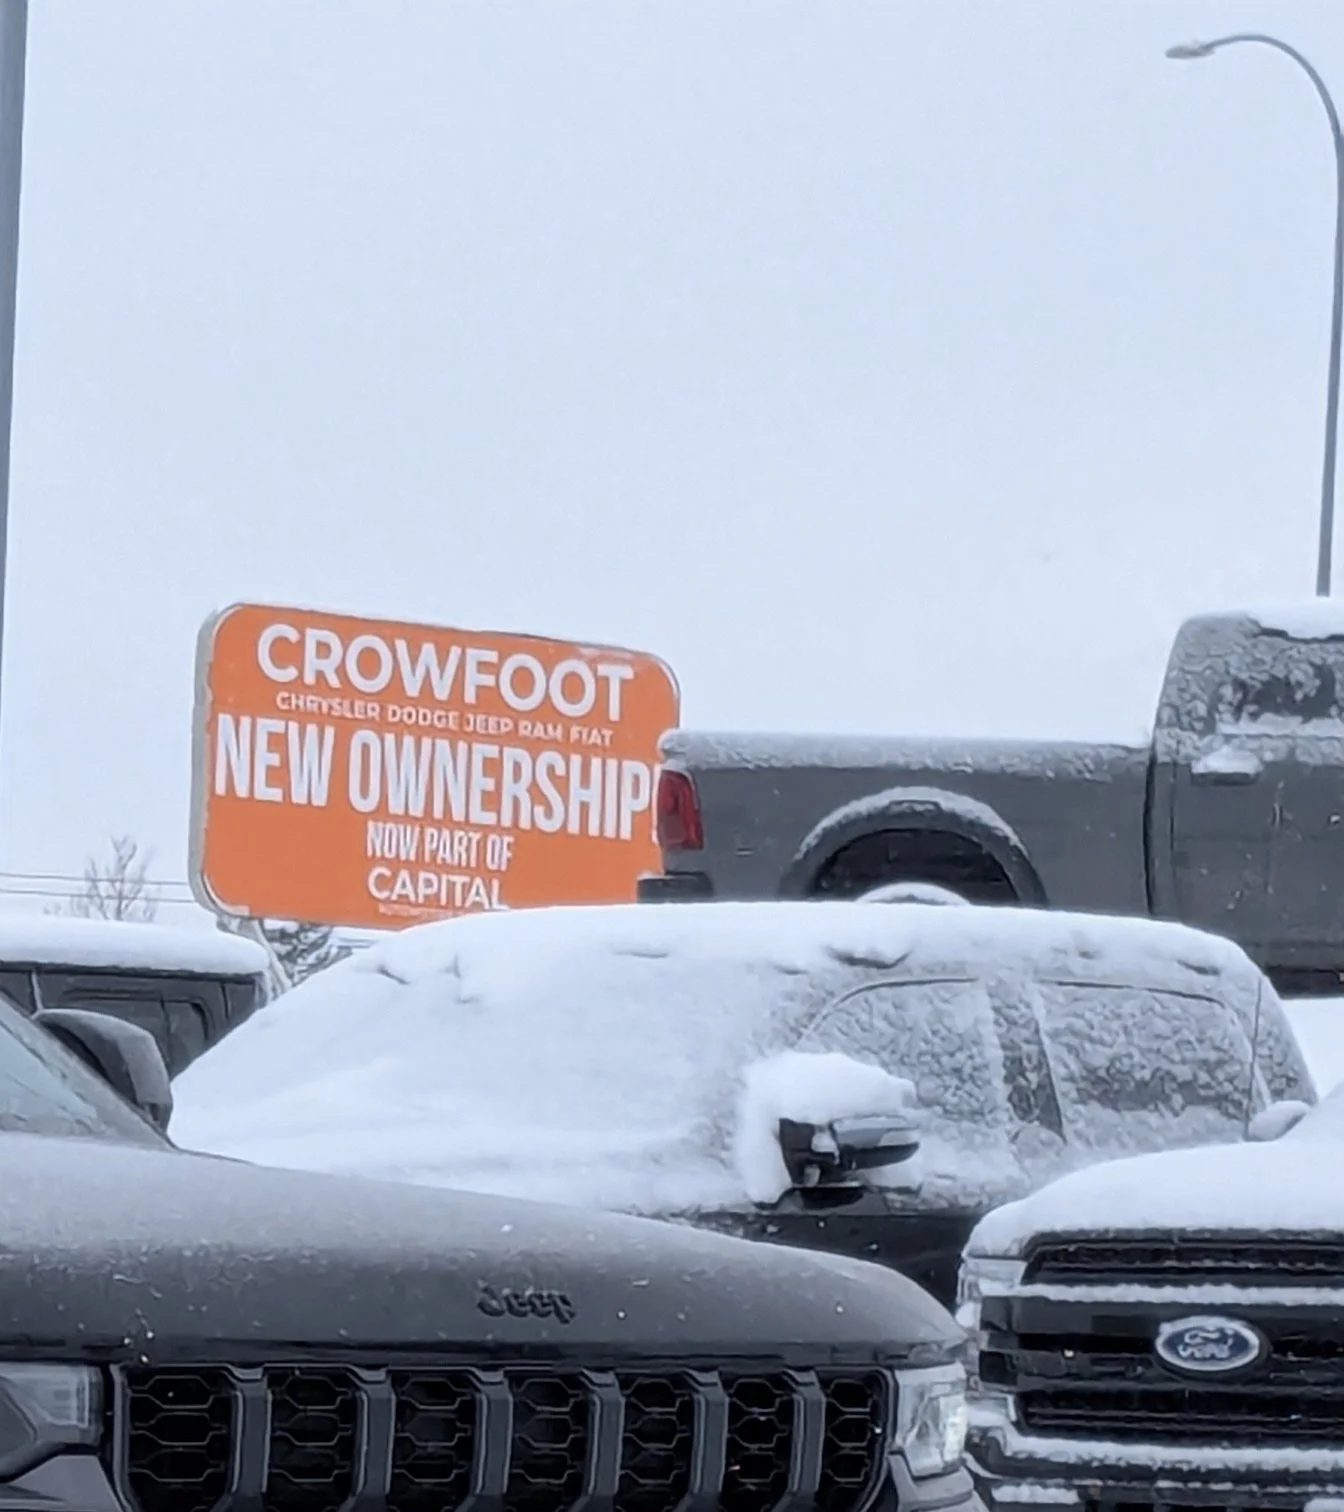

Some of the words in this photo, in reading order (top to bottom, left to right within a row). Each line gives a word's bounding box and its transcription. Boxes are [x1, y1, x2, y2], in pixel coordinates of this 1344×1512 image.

[257, 623, 633, 721] CROWFOOT
[275, 691, 381, 721] CHRYSLER
[387, 706, 459, 732] DODGE
[464, 715, 512, 735] JEEP
[518, 720, 563, 742] RAM
[570, 725, 614, 748] FIAT
[214, 713, 334, 807] NEW
[366, 821, 418, 861] NOW
[424, 829, 482, 866] PART
[486, 834, 514, 872] OF
[368, 866, 511, 911] CAPITAL
